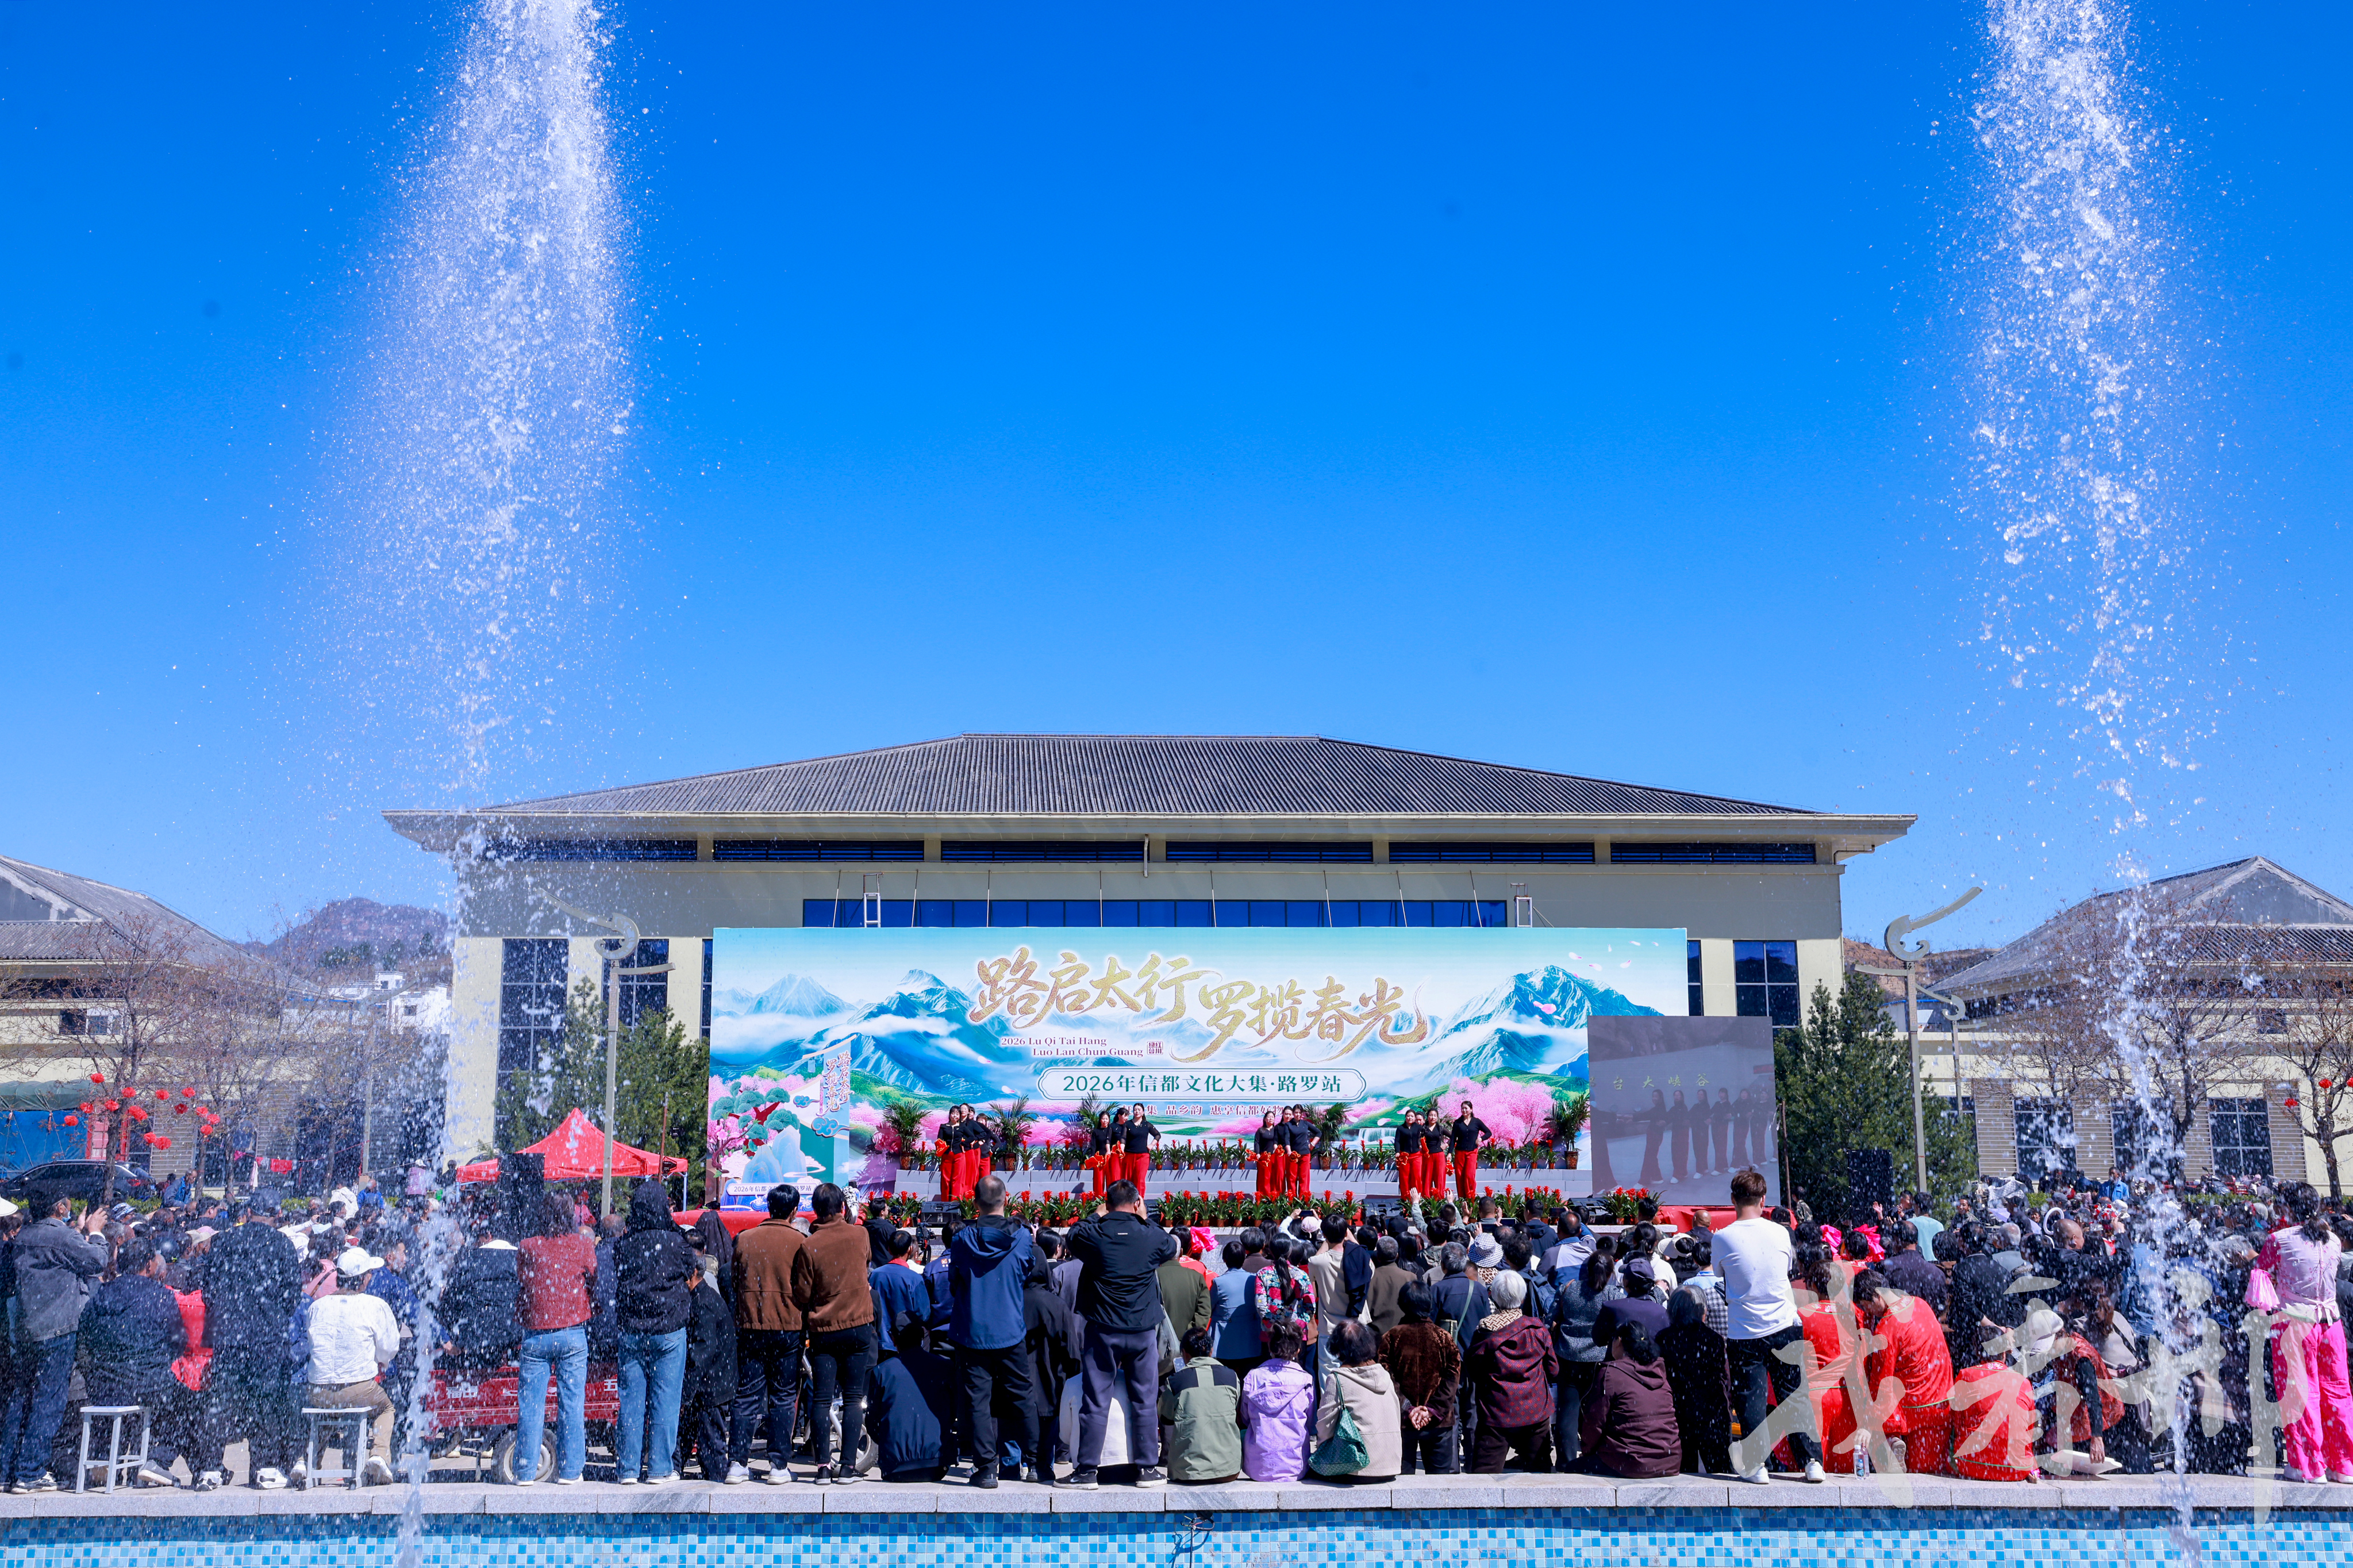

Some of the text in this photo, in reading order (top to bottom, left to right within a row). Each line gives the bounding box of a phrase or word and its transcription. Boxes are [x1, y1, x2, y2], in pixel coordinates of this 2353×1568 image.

[968, 947, 1429, 1063] 路启太行 罗揽春光
[1001, 1037, 1107, 1046] 2026 Lu Qi Tai Hang
[1033, 1047, 1143, 1058] Luo Lan Chun Guang
[836, 1050, 855, 1105] 路启太行
[1063, 1075, 1341, 1093] 2026年信都文化大集·路罗站
[1166, 1105, 1202, 1115] 品乡韵
